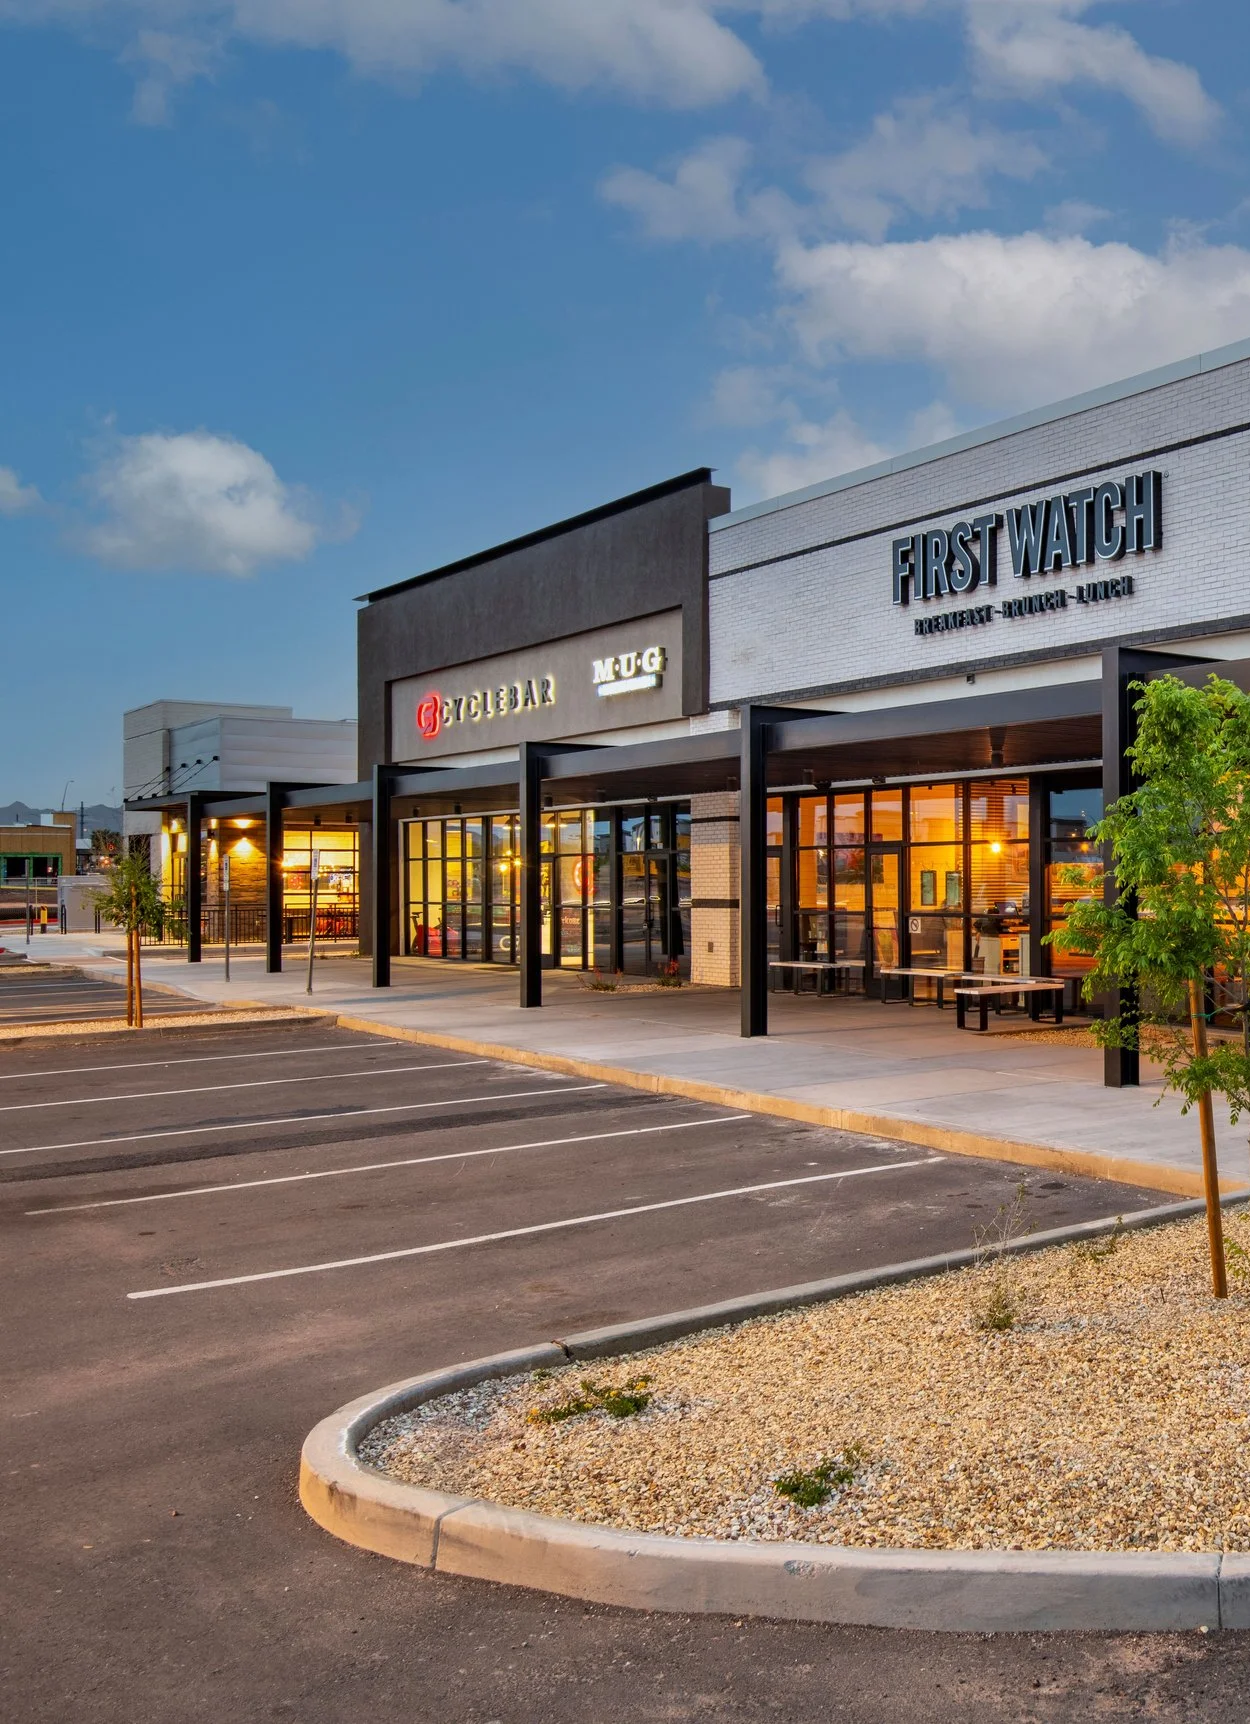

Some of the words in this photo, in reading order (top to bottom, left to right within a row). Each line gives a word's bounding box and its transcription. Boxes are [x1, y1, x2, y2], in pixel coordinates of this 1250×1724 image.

[892, 513, 1003, 605] FIRST
[1006, 470, 1162, 578] WATCH
[914, 604, 994, 635] BREAKFAST
[1002, 589, 1067, 619] BRUNCH
[1076, 575, 1134, 605] LUNCH
[441, 678, 554, 726] CYCLEBAR
